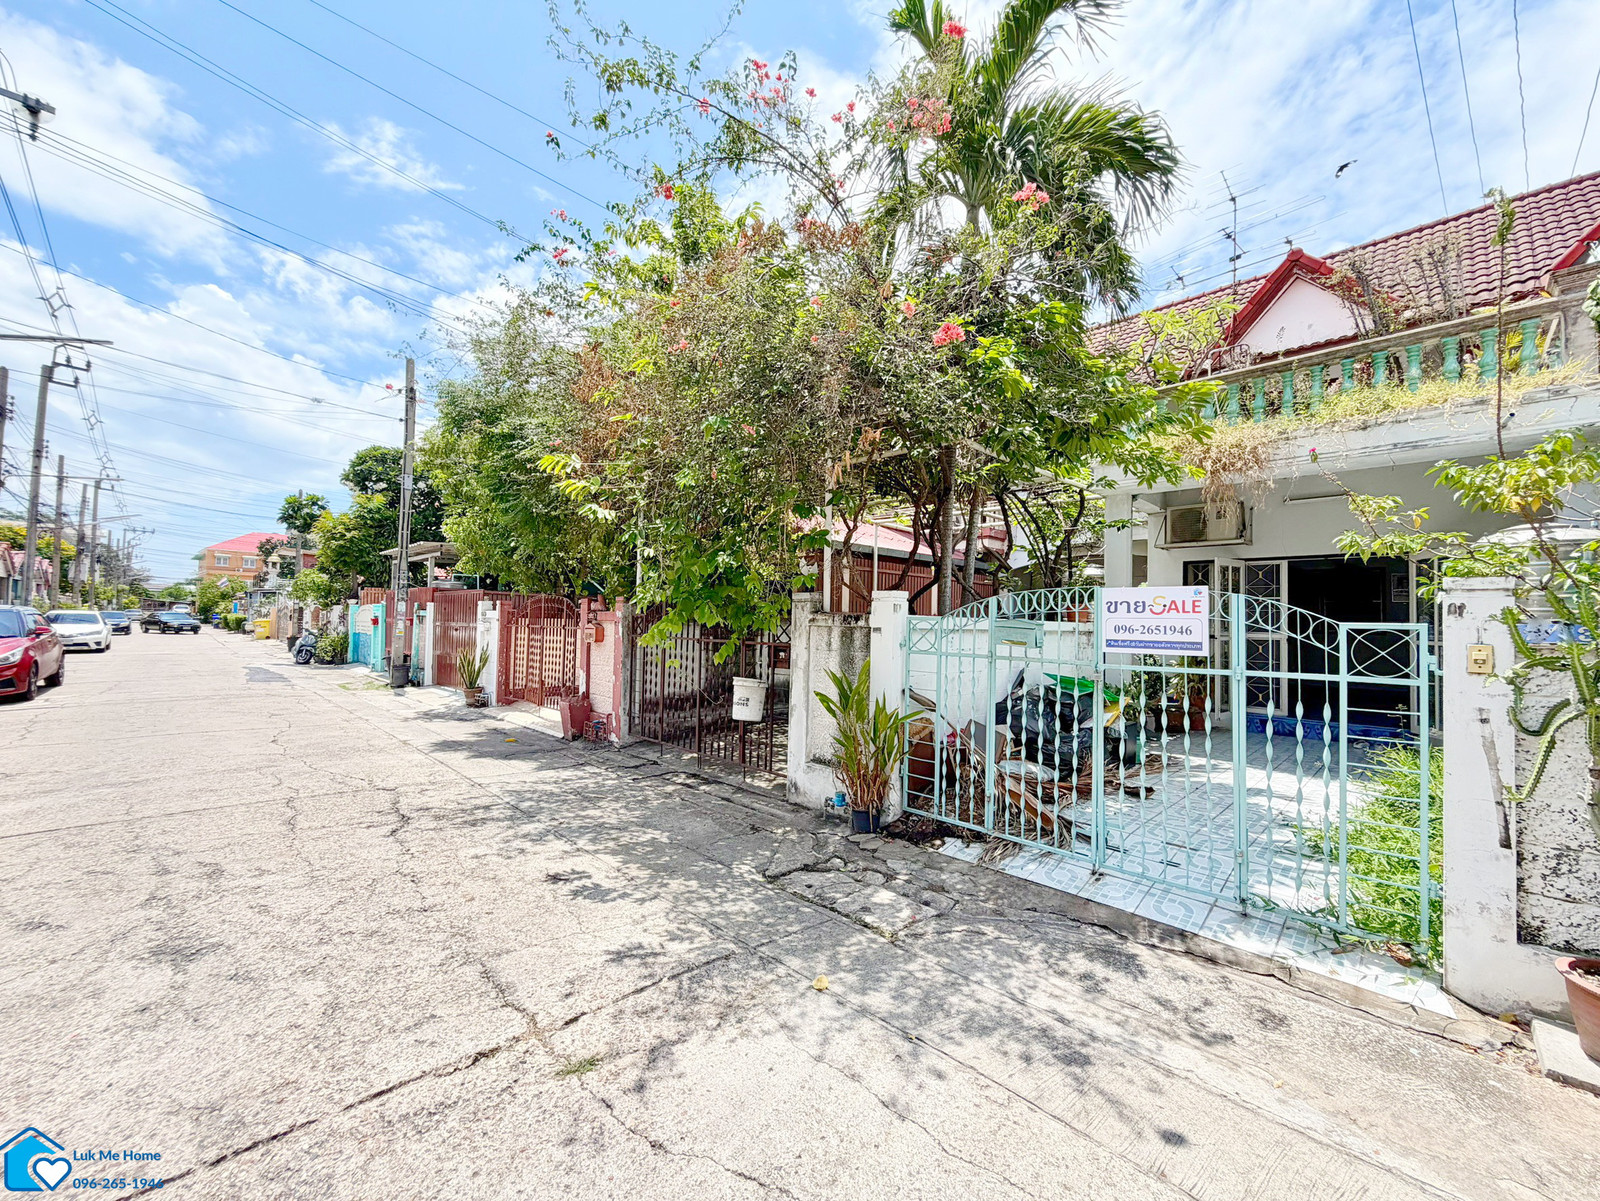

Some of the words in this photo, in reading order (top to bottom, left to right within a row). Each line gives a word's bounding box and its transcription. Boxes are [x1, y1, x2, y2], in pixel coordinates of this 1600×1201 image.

[1106, 600, 1146, 614] ขาย
[1149, 595, 1202, 615] SALE
[1113, 624, 1193, 635] 096-2651946
